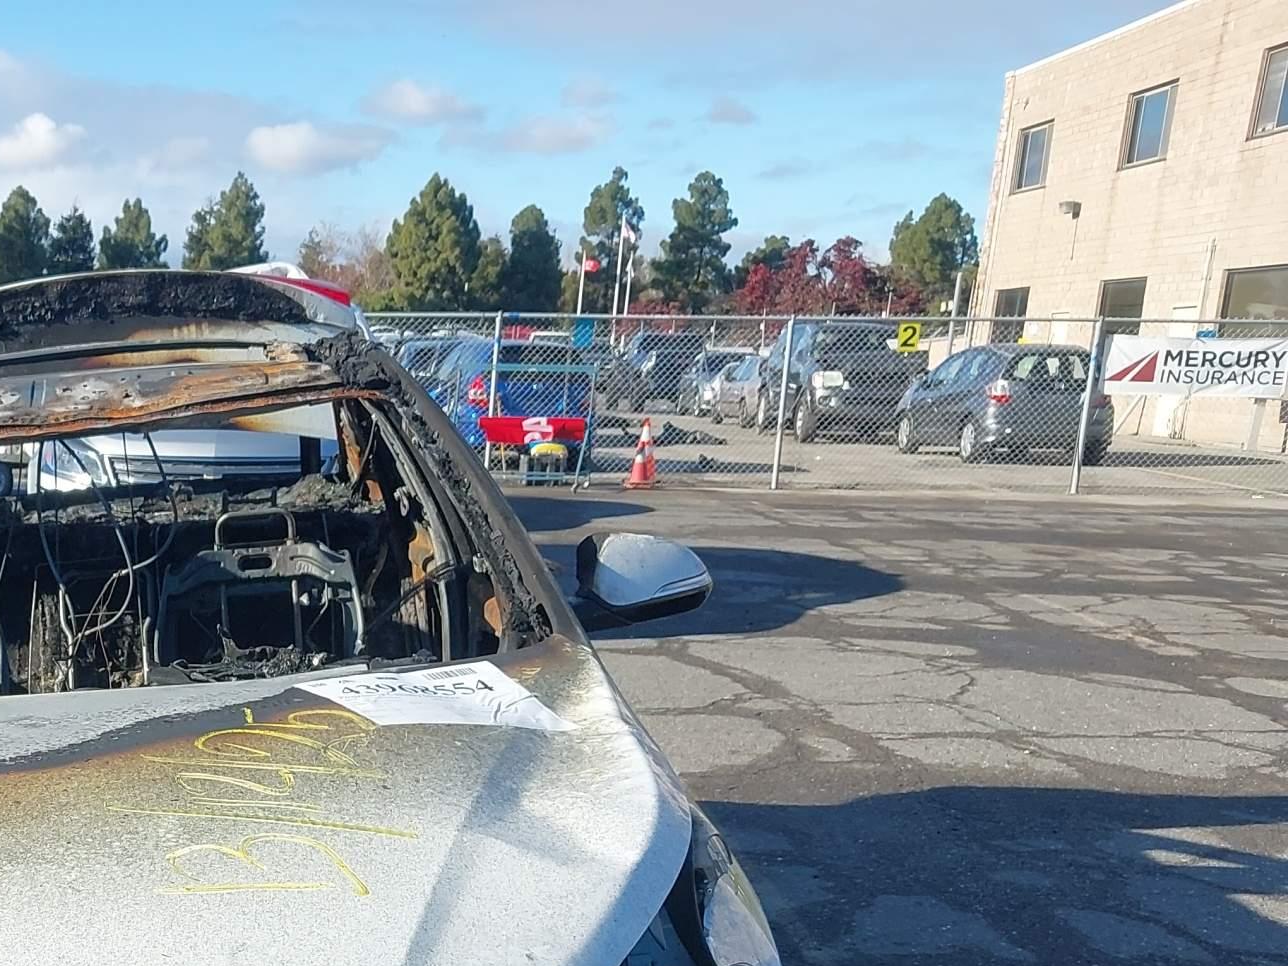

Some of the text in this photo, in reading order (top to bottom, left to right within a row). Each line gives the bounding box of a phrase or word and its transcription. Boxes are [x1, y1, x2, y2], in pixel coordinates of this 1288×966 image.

[900, 325, 917, 348] 2
[1163, 350, 1287, 369] MERCURY
[1159, 369, 1284, 385] INSURANCE
[341, 679, 495, 697] 43968554
